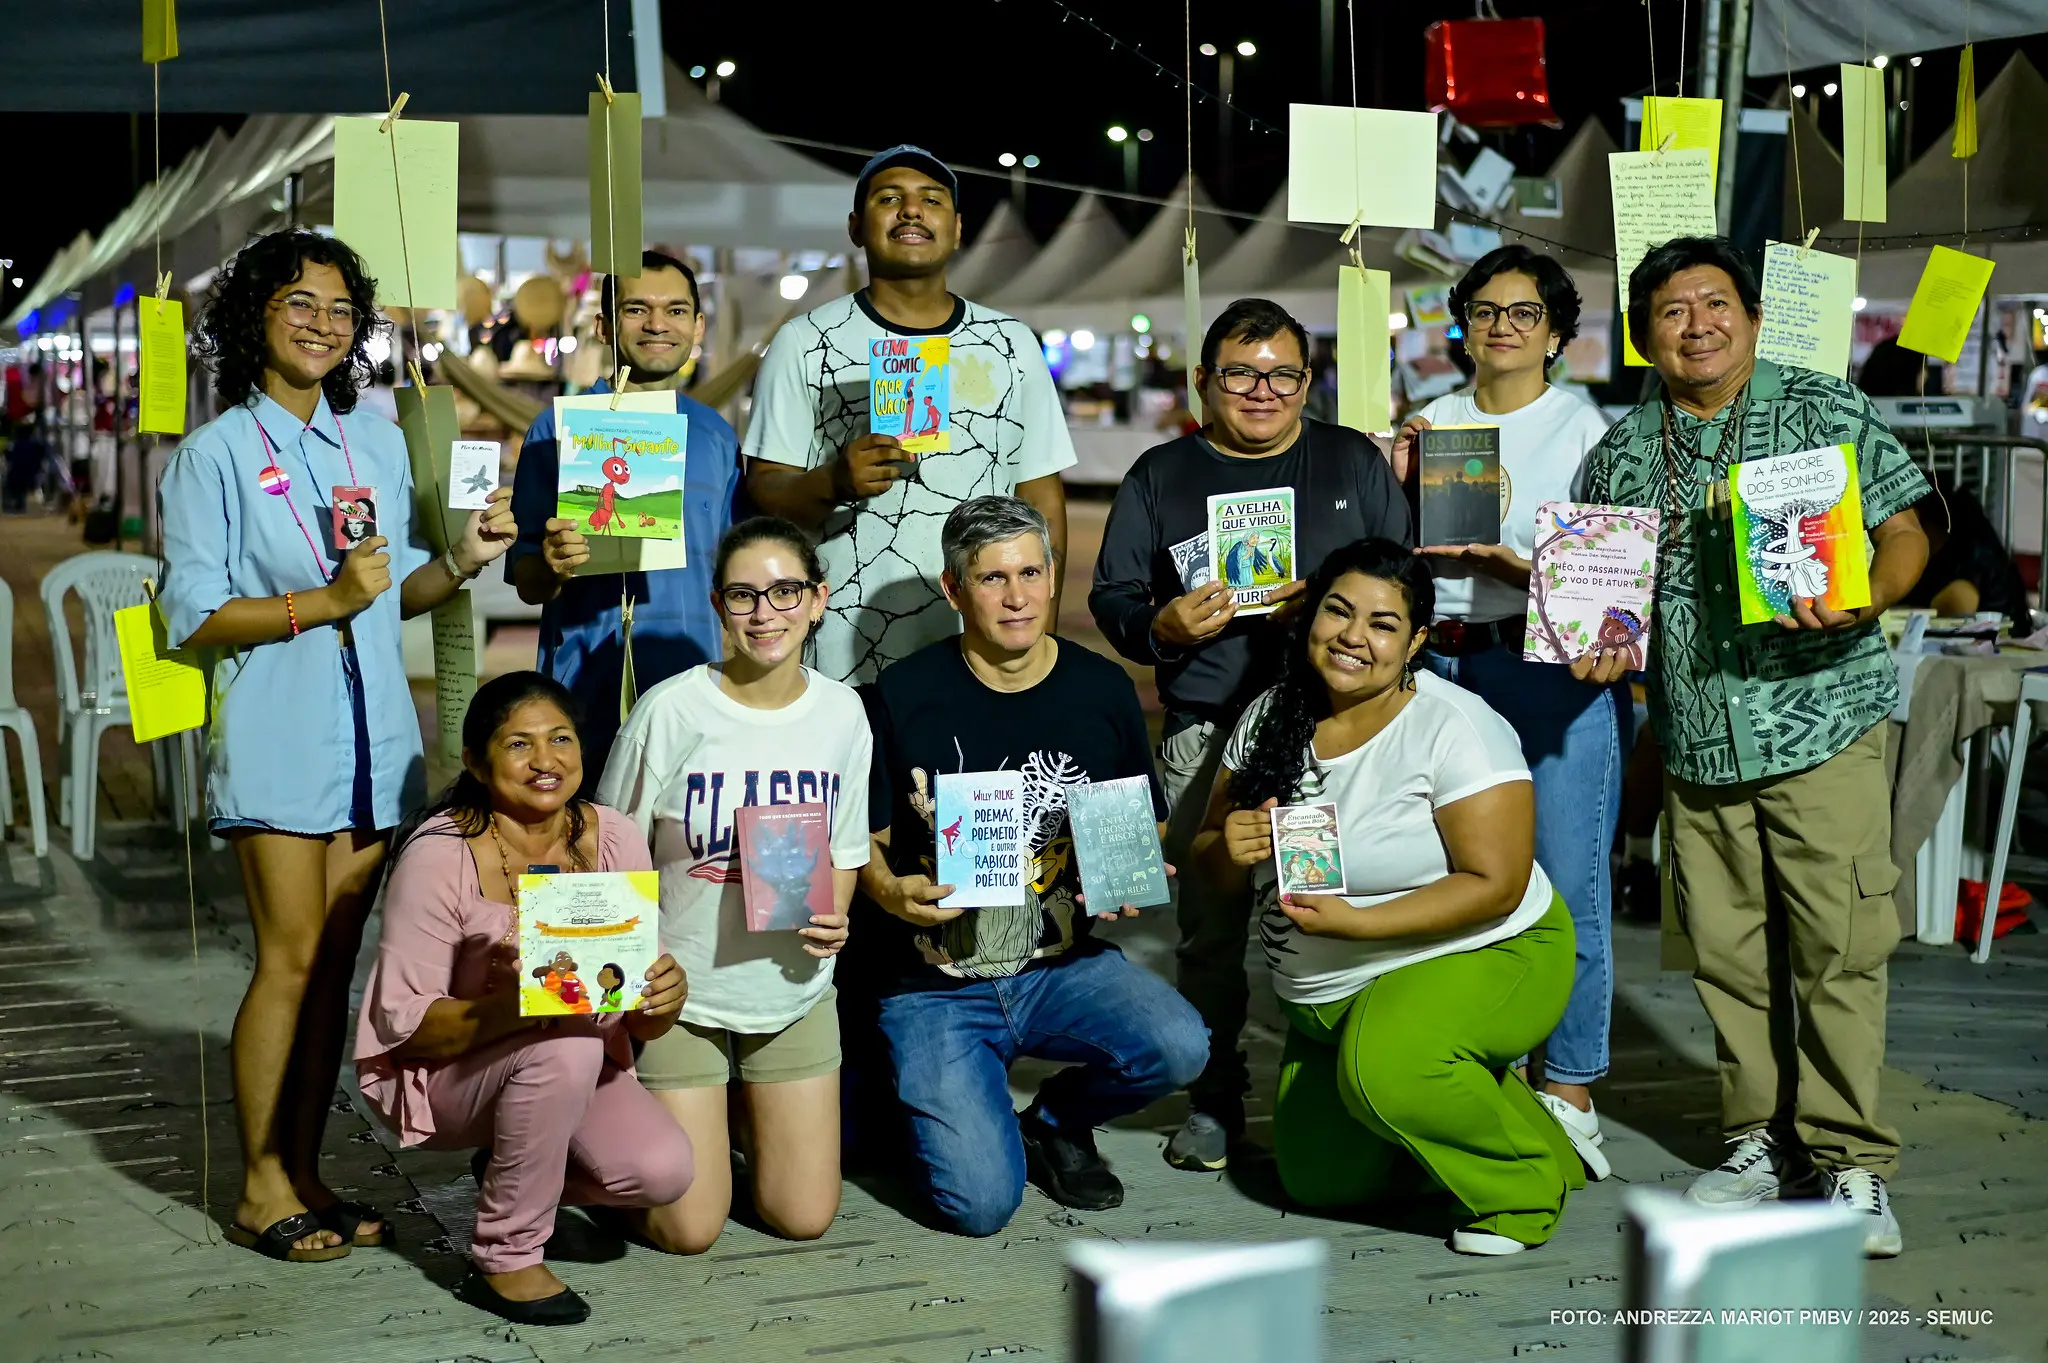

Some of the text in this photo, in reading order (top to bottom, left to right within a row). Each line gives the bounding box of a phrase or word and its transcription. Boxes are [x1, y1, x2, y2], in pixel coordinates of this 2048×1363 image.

[872, 339, 909, 357] CENA
[883, 357, 921, 374] COMIC
[622, 436, 680, 456] Gigante
[1425, 433, 1493, 450] OS DOZE
[1754, 455, 1824, 478] A ÁRVORE
[1747, 469, 1835, 495] DOS SONHOS
[1225, 501, 1281, 517] A VELHA
[1222, 514, 1286, 530] QUE VIROU
[1550, 562, 1576, 573] THÉO,
[1588, 565, 1645, 578] PASSARINHO,
[1553, 575, 1558, 583] E
[1570, 576, 1589, 585] VOO
[1592, 577, 1603, 586] DE
[994, 789, 1015, 801] RILKE
[1287, 813, 1325, 821] Encantado
[971, 825, 1018, 841] POEMETOS
[1098, 821, 1136, 836] PROSAS
[1108, 831, 1137, 843] RISOS
[991, 842, 1017, 852] E OUTROS
[975, 854, 1018, 869] RABISCOS
[975, 869, 1020, 888] POÉTICOS
[1127, 884, 1152, 894] RILKE
